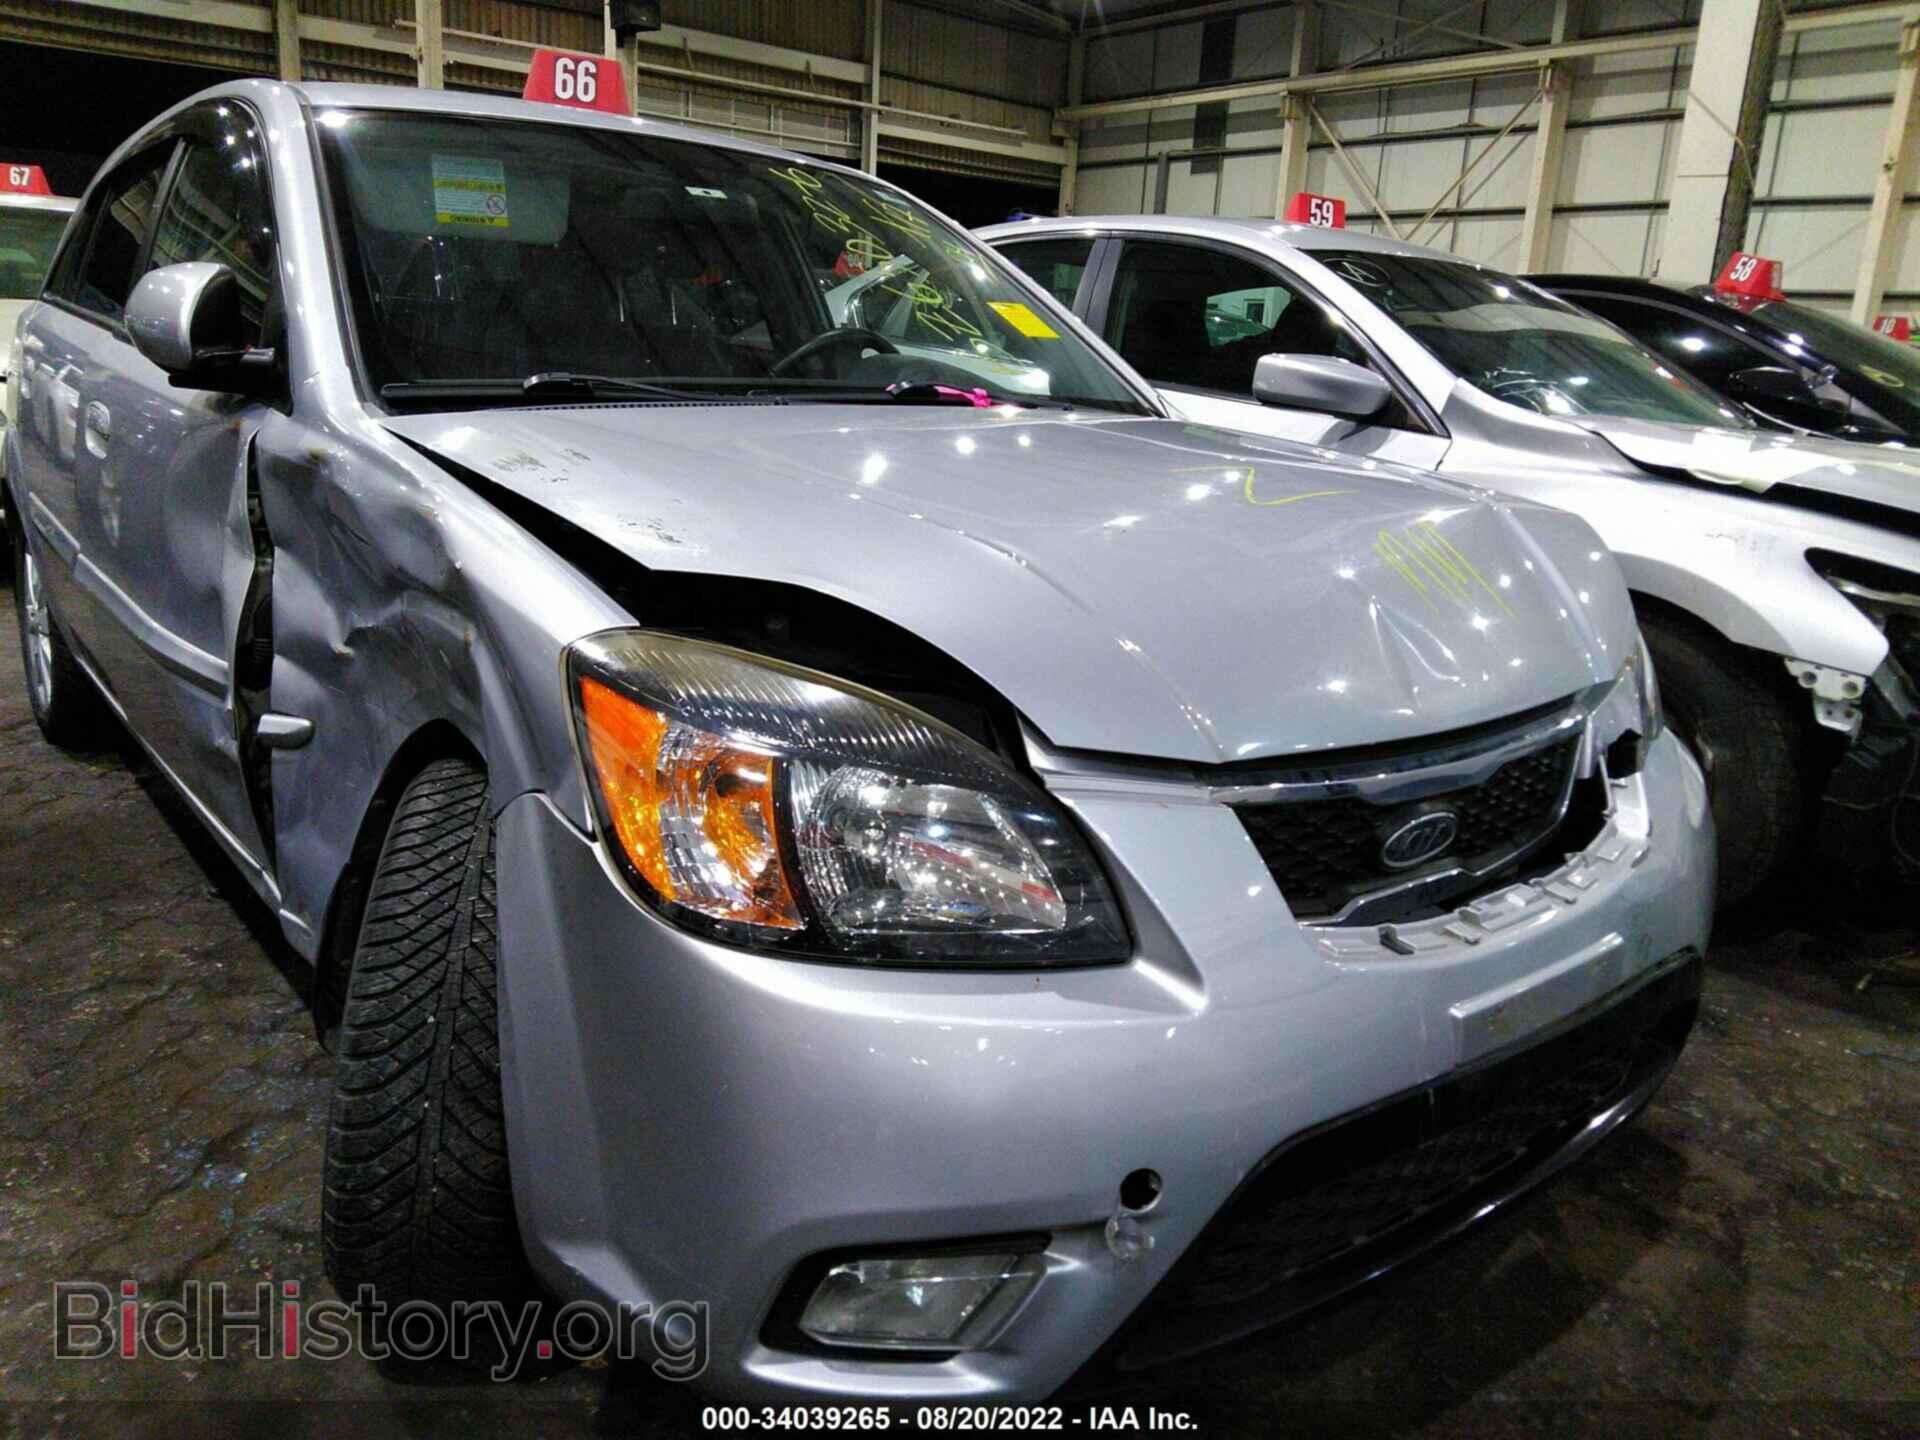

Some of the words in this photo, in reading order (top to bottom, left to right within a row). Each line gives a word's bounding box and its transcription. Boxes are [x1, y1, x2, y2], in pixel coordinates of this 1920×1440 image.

[554, 57, 597, 103] 66
[9, 166, 30, 187] 67
[1310, 198, 1334, 229] 59
[1729, 255, 1758, 282] 58
